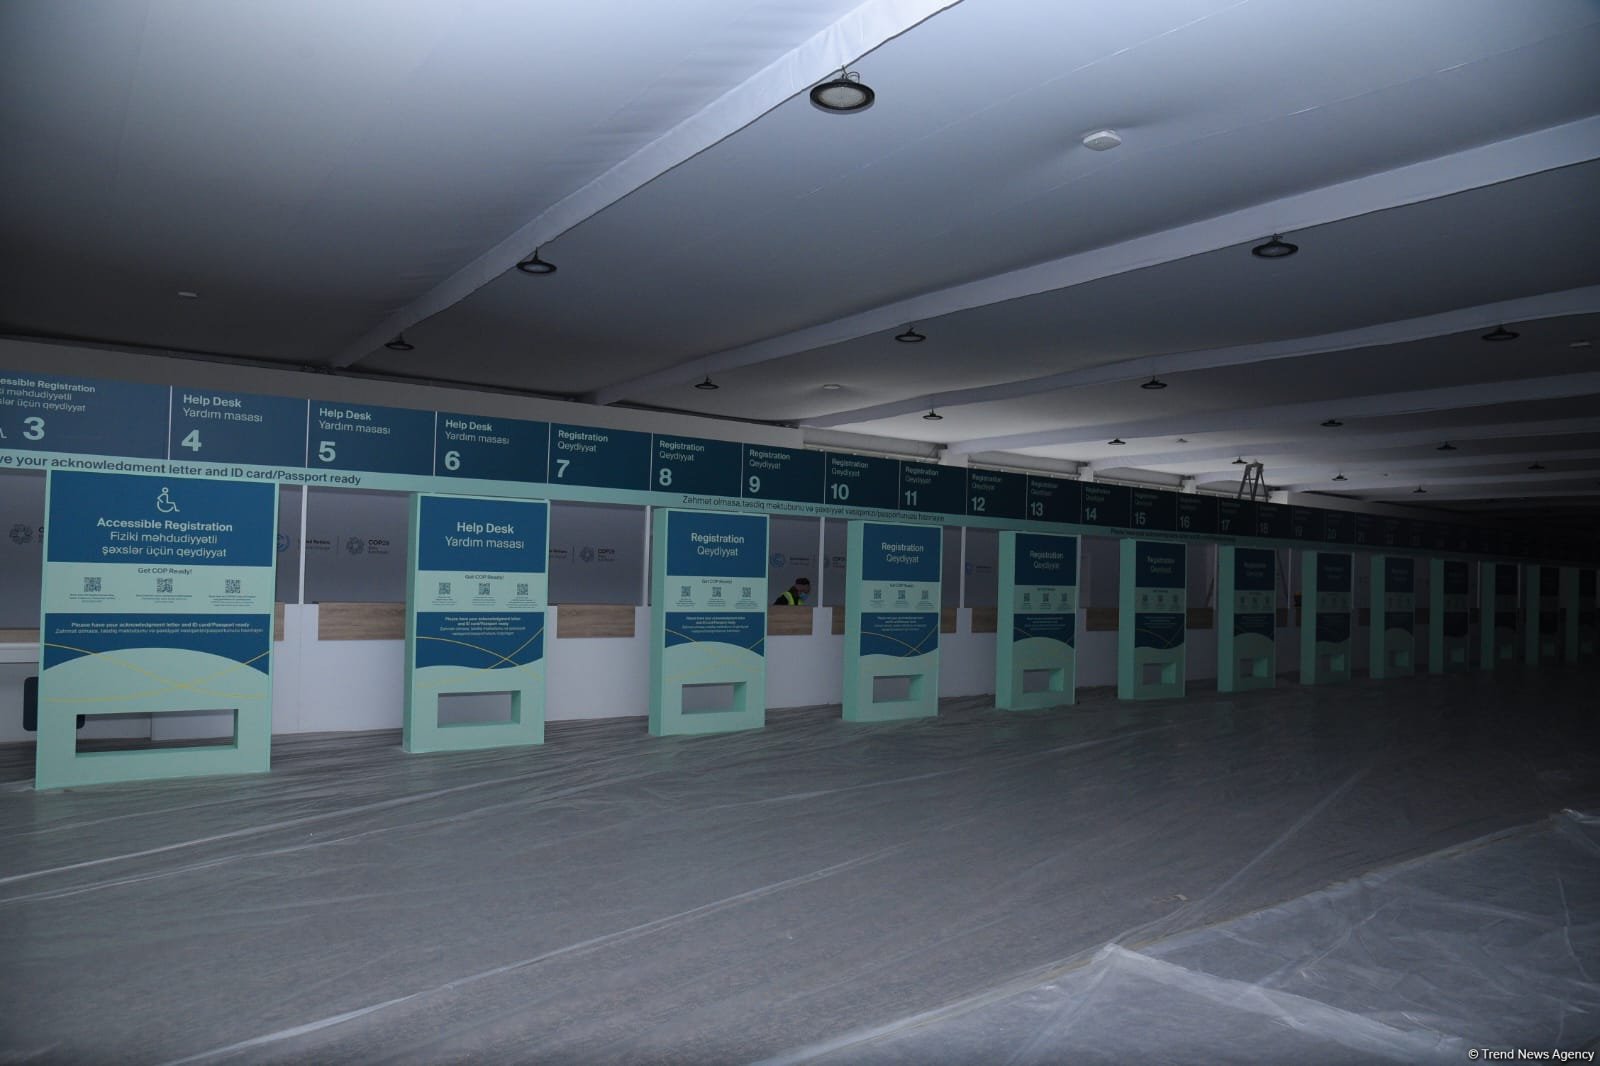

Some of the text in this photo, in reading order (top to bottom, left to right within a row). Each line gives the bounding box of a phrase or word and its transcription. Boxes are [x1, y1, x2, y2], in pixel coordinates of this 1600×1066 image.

[0, 377, 96, 393] essible Registration
[17, 399, 41, 409] üçün
[42, 401, 86, 413] qeydiyyat
[183, 394, 242, 408] Help Desk
[183, 407, 263, 423] Yardım masası
[319, 407, 372, 421] Help Desk
[23, 416, 45, 440] 3
[319, 420, 391, 435] Yardım masası
[445, 419, 493, 432] Help Desk
[181, 430, 202, 452] 4
[445, 431, 510, 445] Yardım masası
[558, 430, 608, 443] Registration
[318, 440, 336, 462] 5
[557, 441, 597, 453] Qeydiyyat
[660, 440, 705, 452] Registration
[445, 451, 461, 471] 6
[659, 450, 694, 463] Qeydiyyat
[750, 449, 791, 461] Registration
[16, 456, 48, 467] your
[169, 464, 202, 475] letter
[205, 467, 228, 477] and
[231, 468, 243, 477] ID
[246, 468, 328, 484] card/Passport
[330, 474, 361, 486] ready
[556, 459, 571, 478] 7
[832, 458, 869, 470] Registration
[659, 468, 672, 487] 8
[749, 475, 761, 494] 9
[831, 483, 849, 500] 10
[905, 490, 918, 507] 11
[971, 496, 986, 513] 12
[1030, 502, 1044, 518] 13
[1085, 506, 1097, 521] 14
[1135, 511, 1147, 526] 15
[96, 517, 233, 533] Accessible Registration
[457, 521, 514, 535] Help Desk
[1180, 515, 1191, 529] 16
[110, 531, 217, 545] Fiziki məhdudiyyətli
[445, 535, 525, 550] Yardım masası
[691, 532, 745, 545] Registration
[102, 545, 226, 560] şəxslər üçün qeydiyyat
[697, 545, 738, 558] Qeydiyyat
[881, 542, 925, 553] Registration
[138, 567, 192, 577] Get COP Ready!
